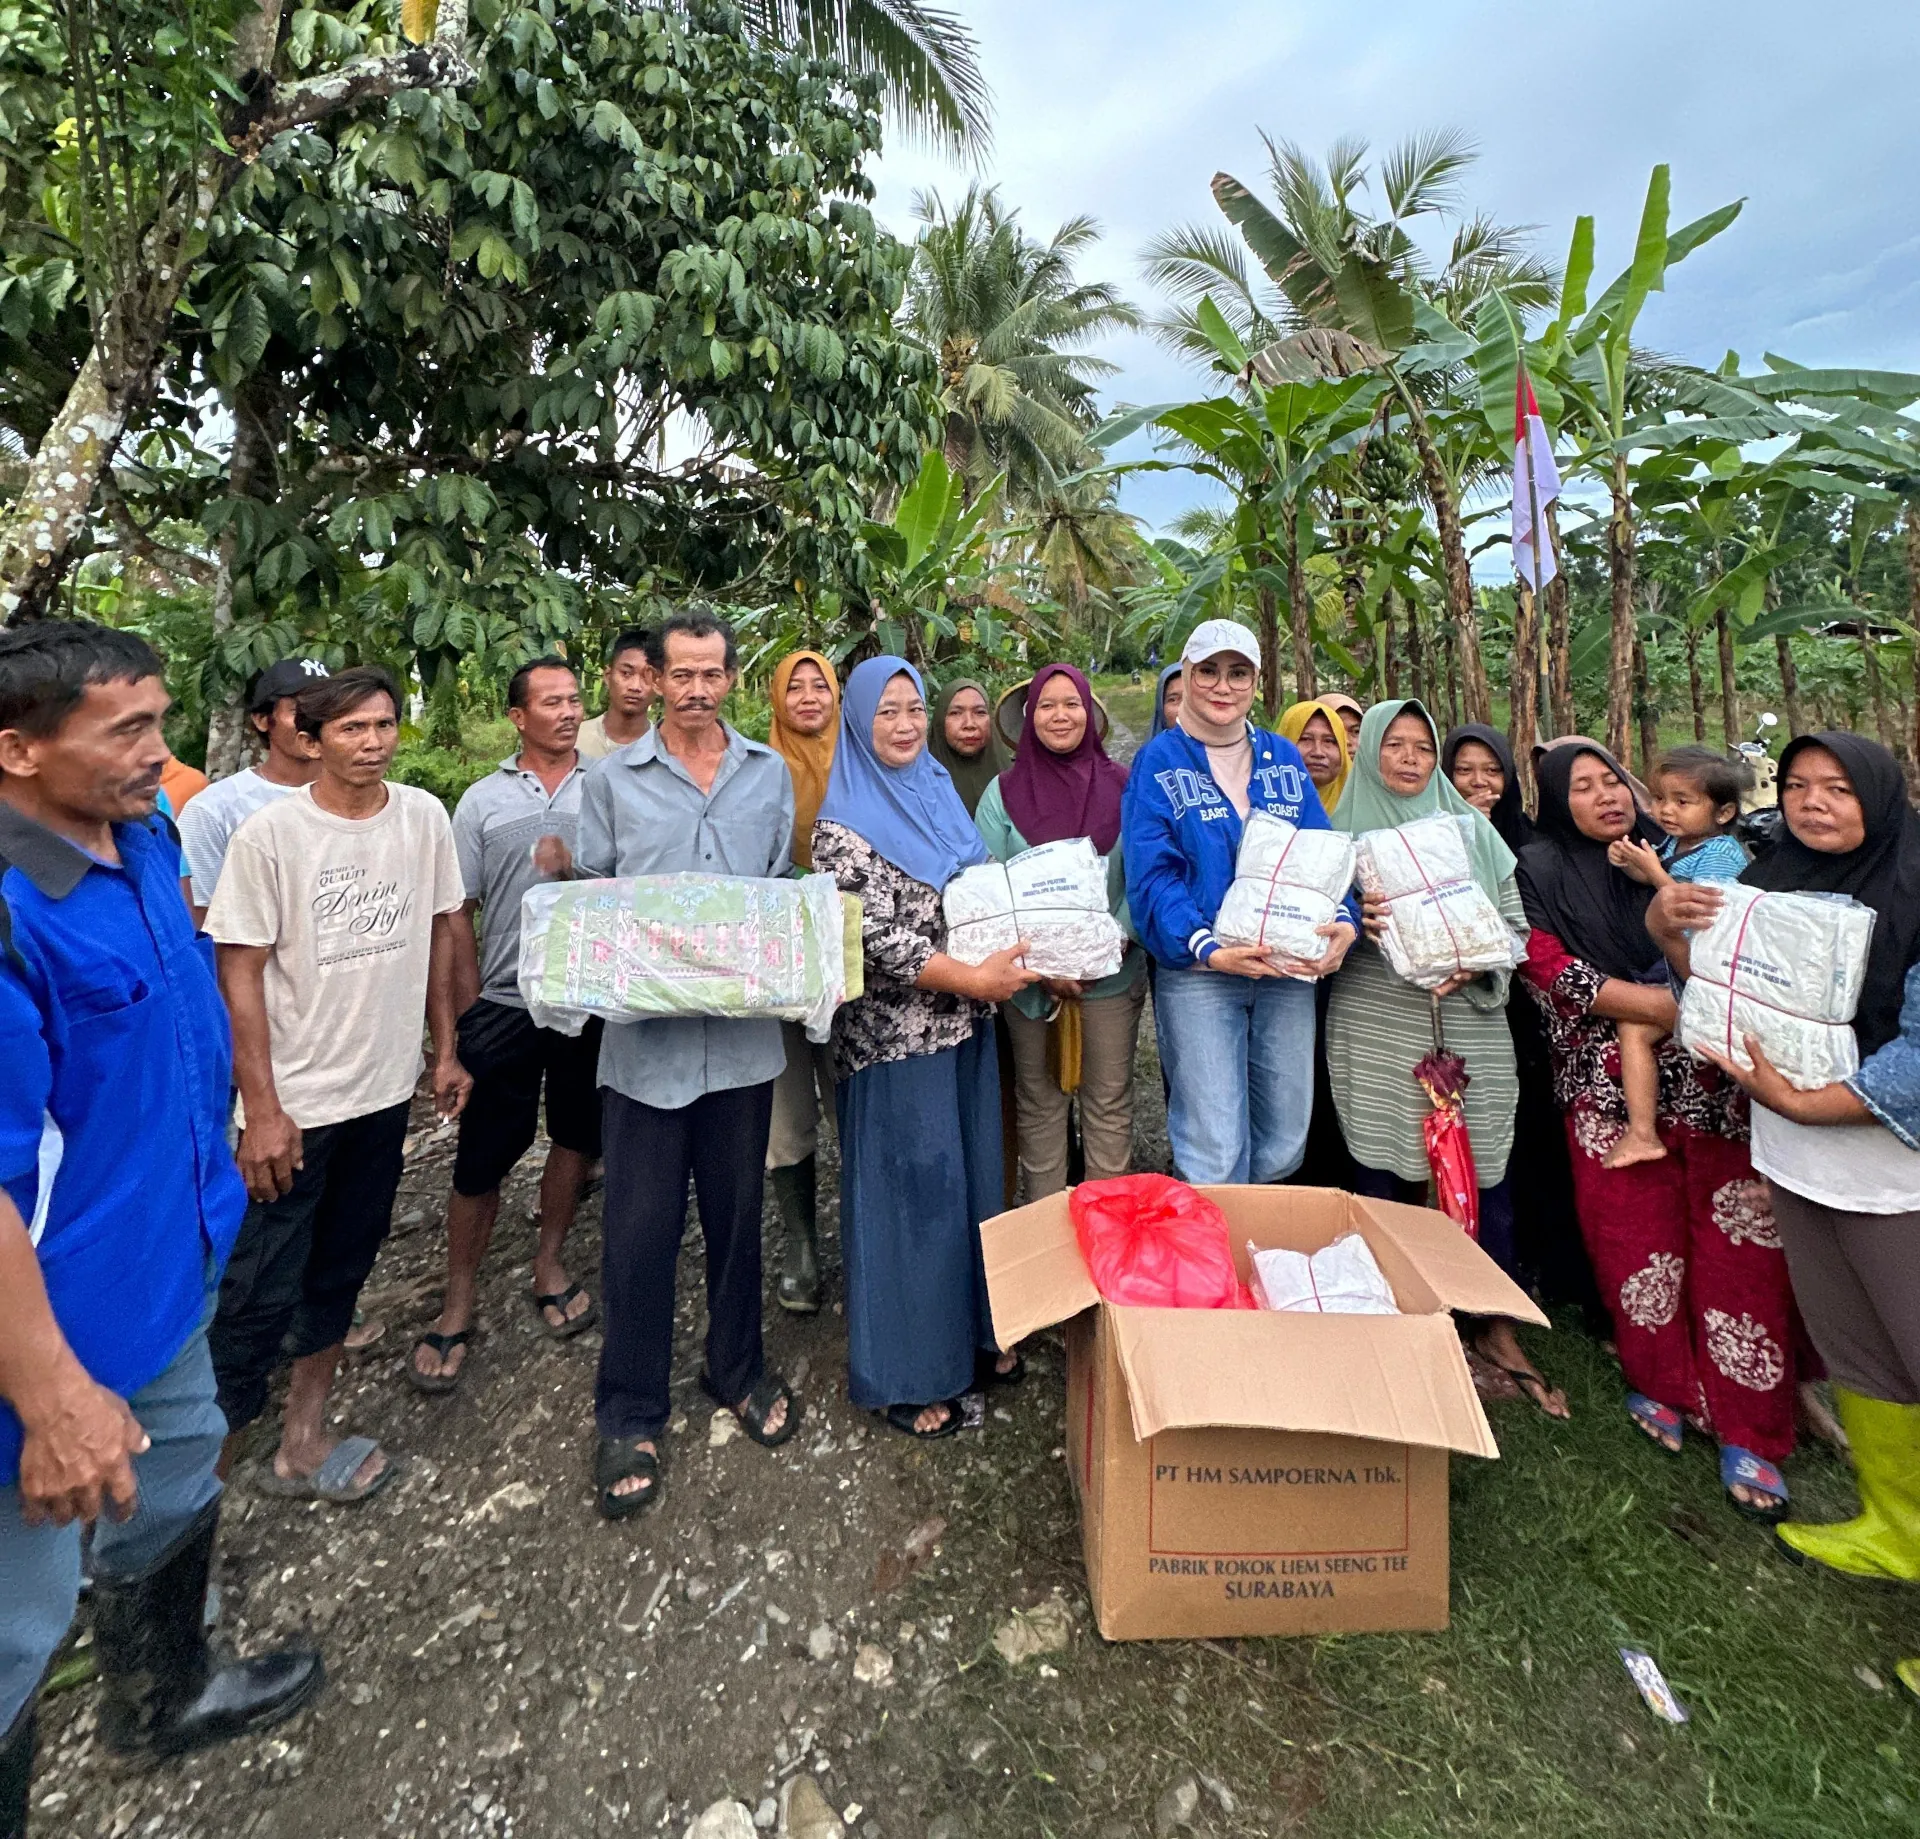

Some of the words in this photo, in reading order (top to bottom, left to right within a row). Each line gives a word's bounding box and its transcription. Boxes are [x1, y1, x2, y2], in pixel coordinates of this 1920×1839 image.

[1199, 807, 1230, 821] EAST
[1267, 803, 1299, 818] COAST
[319, 868, 368, 887] QUALITY
[1156, 1464, 1179, 1482] PT
[1187, 1466, 1222, 1483] HM
[1228, 1467, 1357, 1485] SAMPOERNA
[1363, 1466, 1401, 1484] Tbk.
[1149, 1557, 1209, 1576] PABRIK
[1214, 1559, 1275, 1576] ROKOK
[1281, 1559, 1320, 1575] LIEM
[1324, 1556, 1377, 1574] SEENG
[1383, 1556, 1409, 1572] TEE
[1225, 1580, 1335, 1600] SURABAYA
